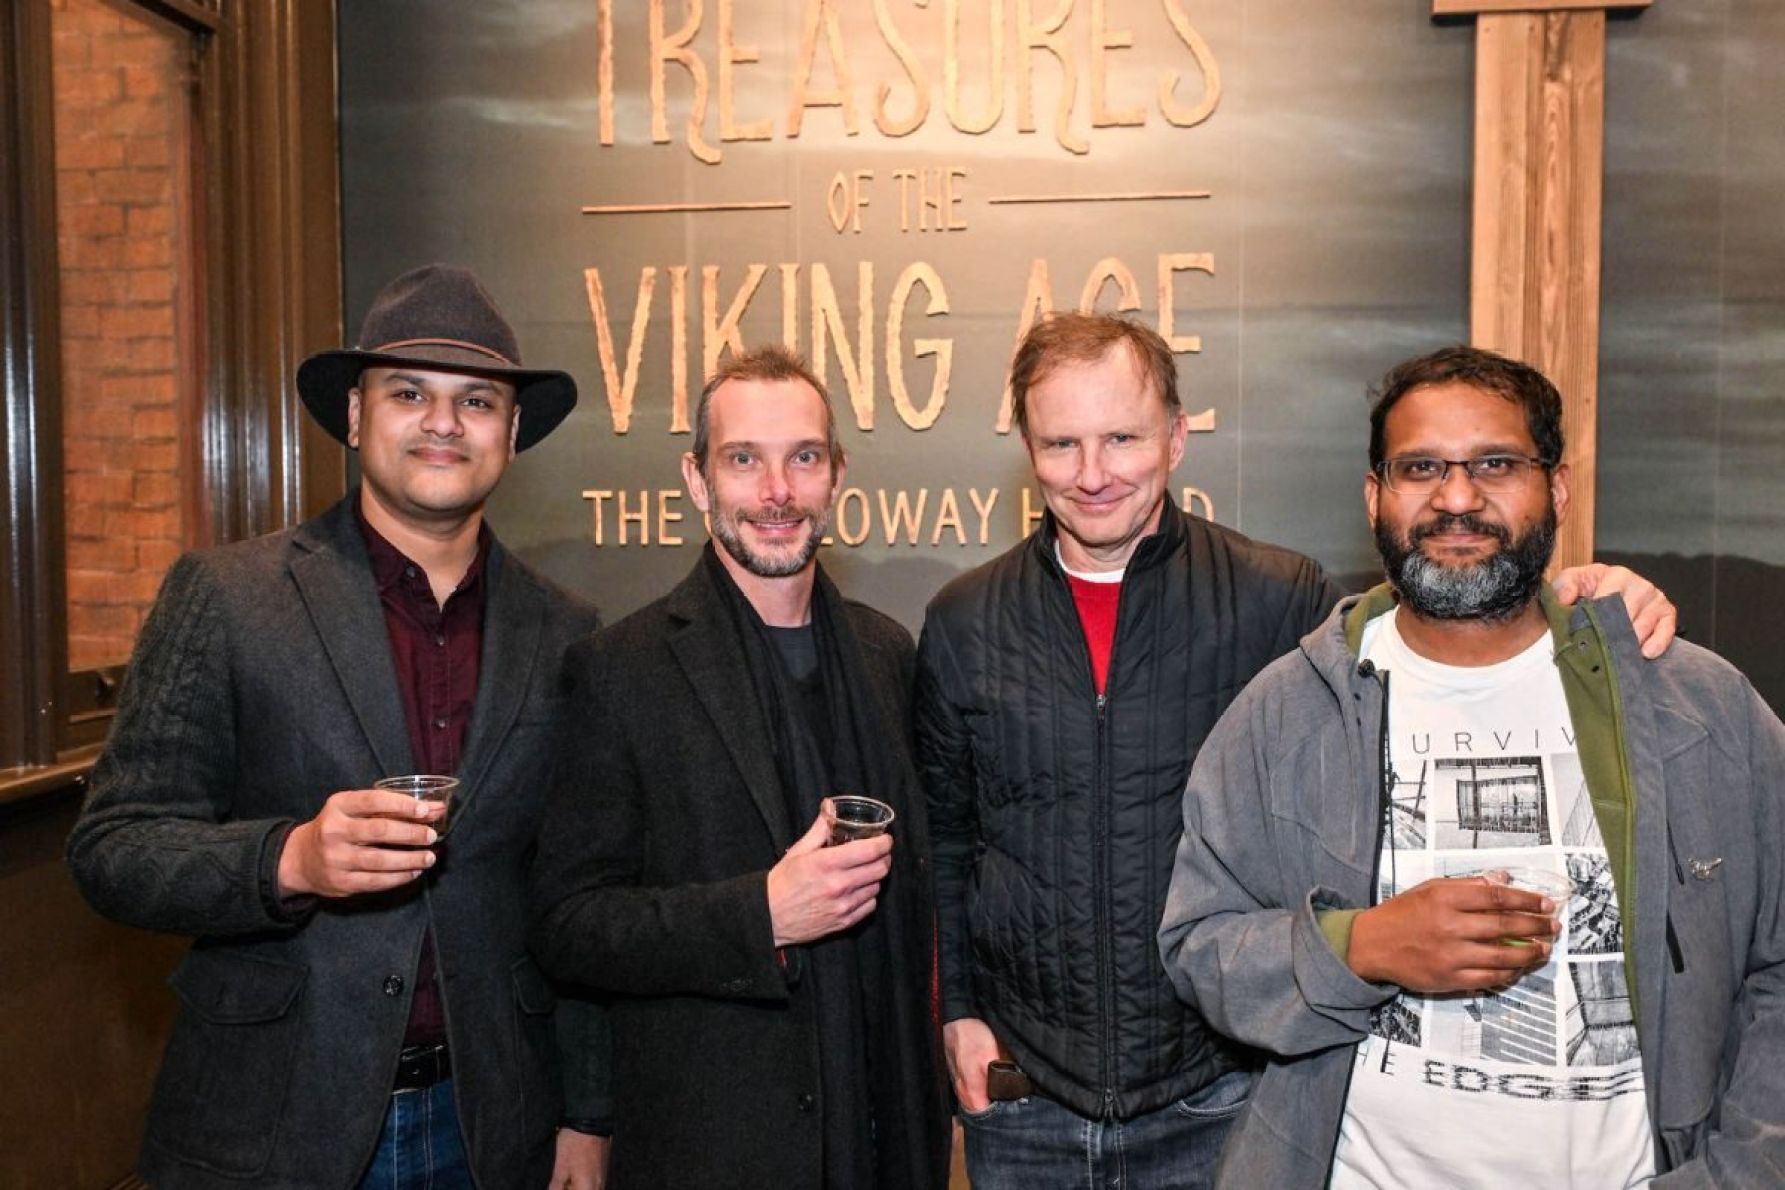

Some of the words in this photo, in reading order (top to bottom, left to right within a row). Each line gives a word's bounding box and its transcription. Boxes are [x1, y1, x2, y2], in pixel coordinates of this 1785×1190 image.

[827, 169, 873, 233] OF
[892, 166, 968, 232] THE
[582, 490, 684, 548] THE
